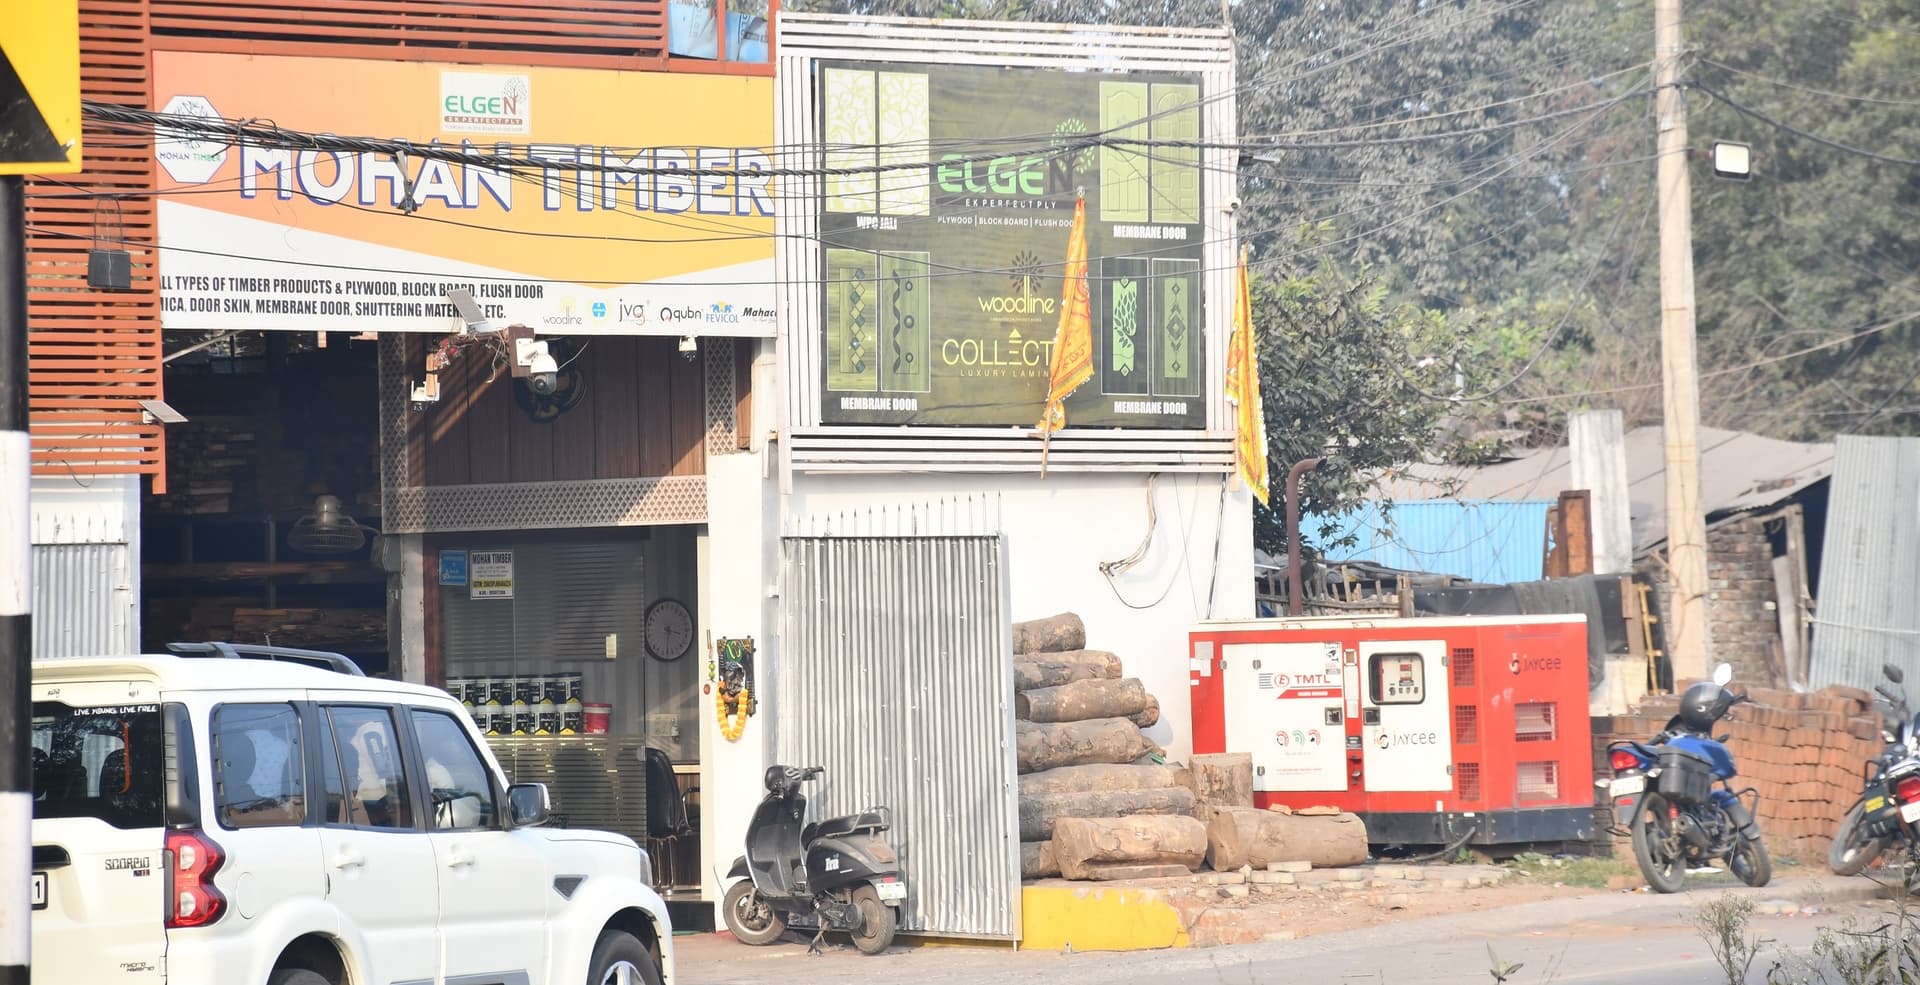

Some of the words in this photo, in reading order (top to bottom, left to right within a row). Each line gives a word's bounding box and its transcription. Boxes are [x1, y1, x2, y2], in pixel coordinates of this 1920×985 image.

[445, 95, 516, 115] ELGEN
[159, 152, 190, 160] MOHAN
[240, 133, 512, 212] MOHAN
[527, 142, 774, 216] TIMBER
[937, 154, 1073, 196] ELGEN
[937, 215, 973, 226] PLYWOOD
[979, 217, 1002, 226] BLOCK
[1003, 217, 1029, 227] BOARD
[1034, 218, 1058, 228] FLUSH
[1059, 219, 1075, 228] DOO
[1113, 225, 1161, 239] MEMBRANE
[1162, 226, 1187, 240] DOOR
[160, 276, 172, 290] LL
[176, 276, 209, 291] TYPES
[212, 277, 226, 291] OF
[229, 277, 270, 293] TIMBER
[273, 278, 332, 294] PRODUCTS
[335, 282, 343, 295] &
[345, 281, 399, 297] PLYWOOD,
[402, 282, 436, 297] BLOCK
[480, 284, 512, 298] FLUSH
[515, 284, 543, 299] DOOR
[190, 298, 220, 313] DOOR
[223, 299, 253, 314] SKIN,
[256, 299, 318, 315] MEMBRANE
[320, 301, 353, 317] DOOR,
[355, 301, 422, 317] SHUTTERING
[485, 304, 506, 319] ETC.
[619, 298, 645, 326] jvg
[706, 313, 739, 324] FEVICOL
[942, 338, 1057, 367] COLLECT
[960, 369, 1006, 377] LUXURY
[840, 396, 891, 411] MEMBRANE
[892, 398, 918, 411] DOOR
[1113, 400, 1161, 414] MEMBRANE
[1162, 401, 1187, 415] DOOR
[1294, 673, 1332, 685] TMTL
[74, 709, 90, 717] LIVE
[120, 706, 136, 714] LIVE
[138, 705, 158, 713] FREE
[105, 857, 150, 871] SCORPIO
